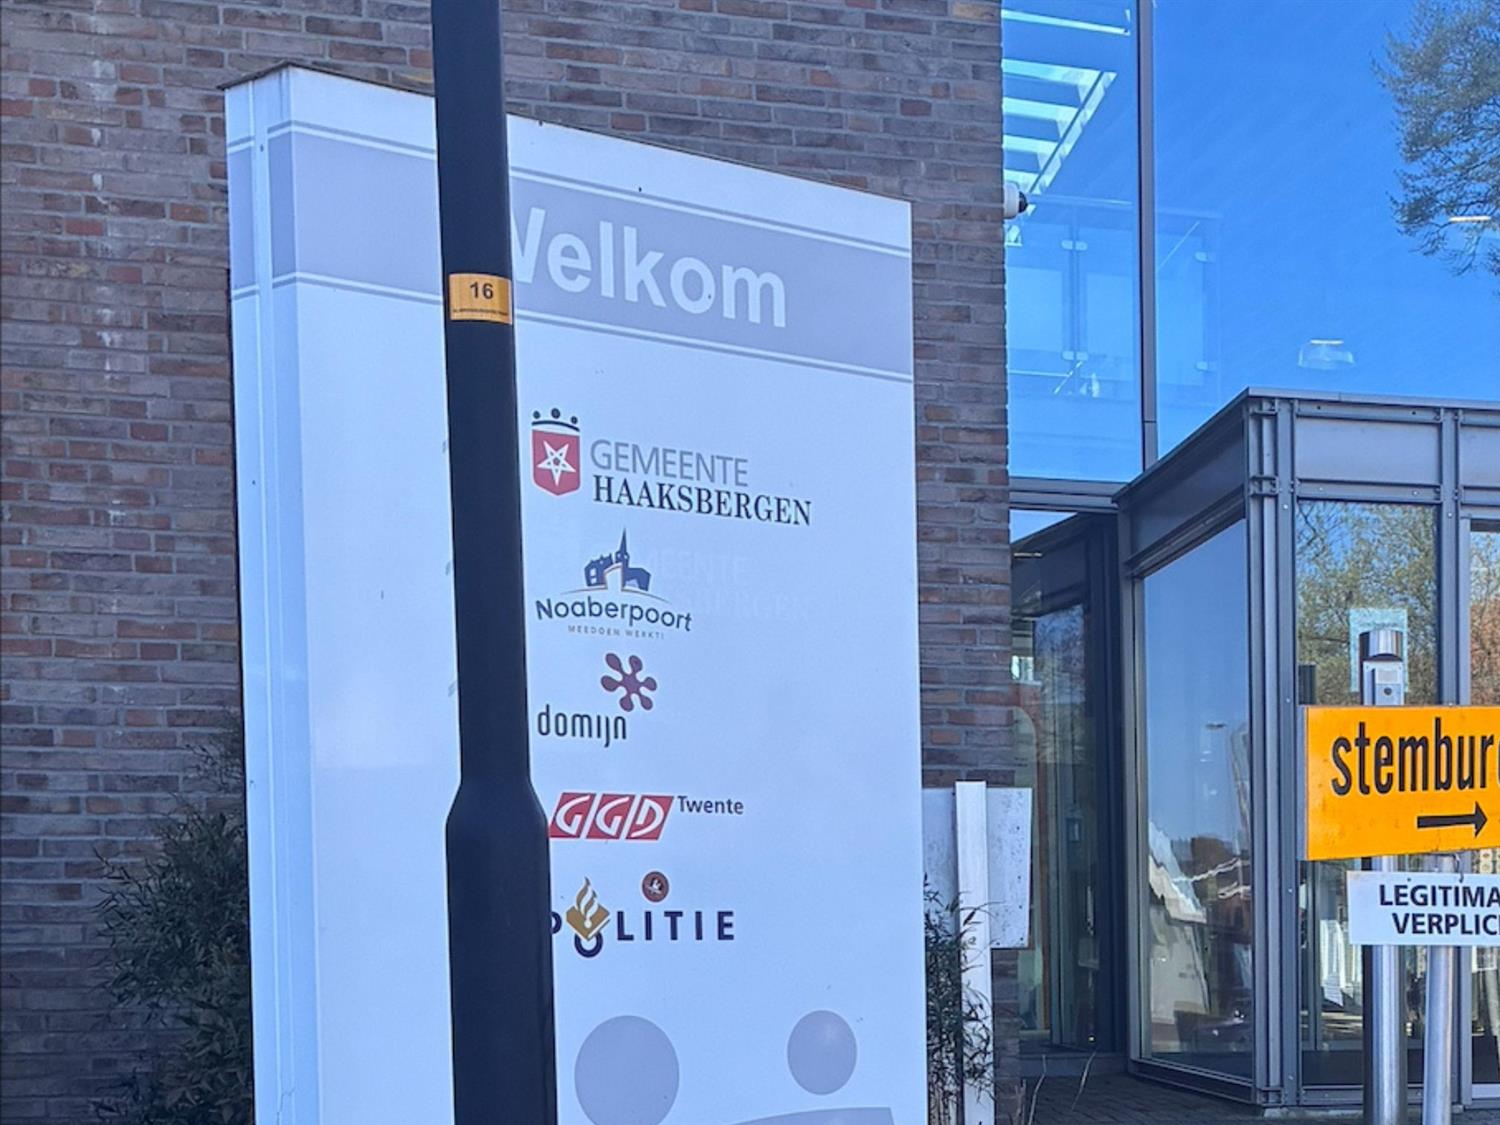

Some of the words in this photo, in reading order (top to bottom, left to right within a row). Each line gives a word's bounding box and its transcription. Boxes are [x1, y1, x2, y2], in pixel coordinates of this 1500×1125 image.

[469, 281, 494, 300] 16
[590, 439, 749, 487] GEMEENTE
[592, 474, 812, 526] HAAKSBERGEN
[535, 596, 693, 632] Noaberpoort
[567, 624, 621, 637] MEEDOEN
[538, 704, 627, 748] domijn
[551, 792, 672, 840] GGD
[677, 795, 744, 815] Twente
